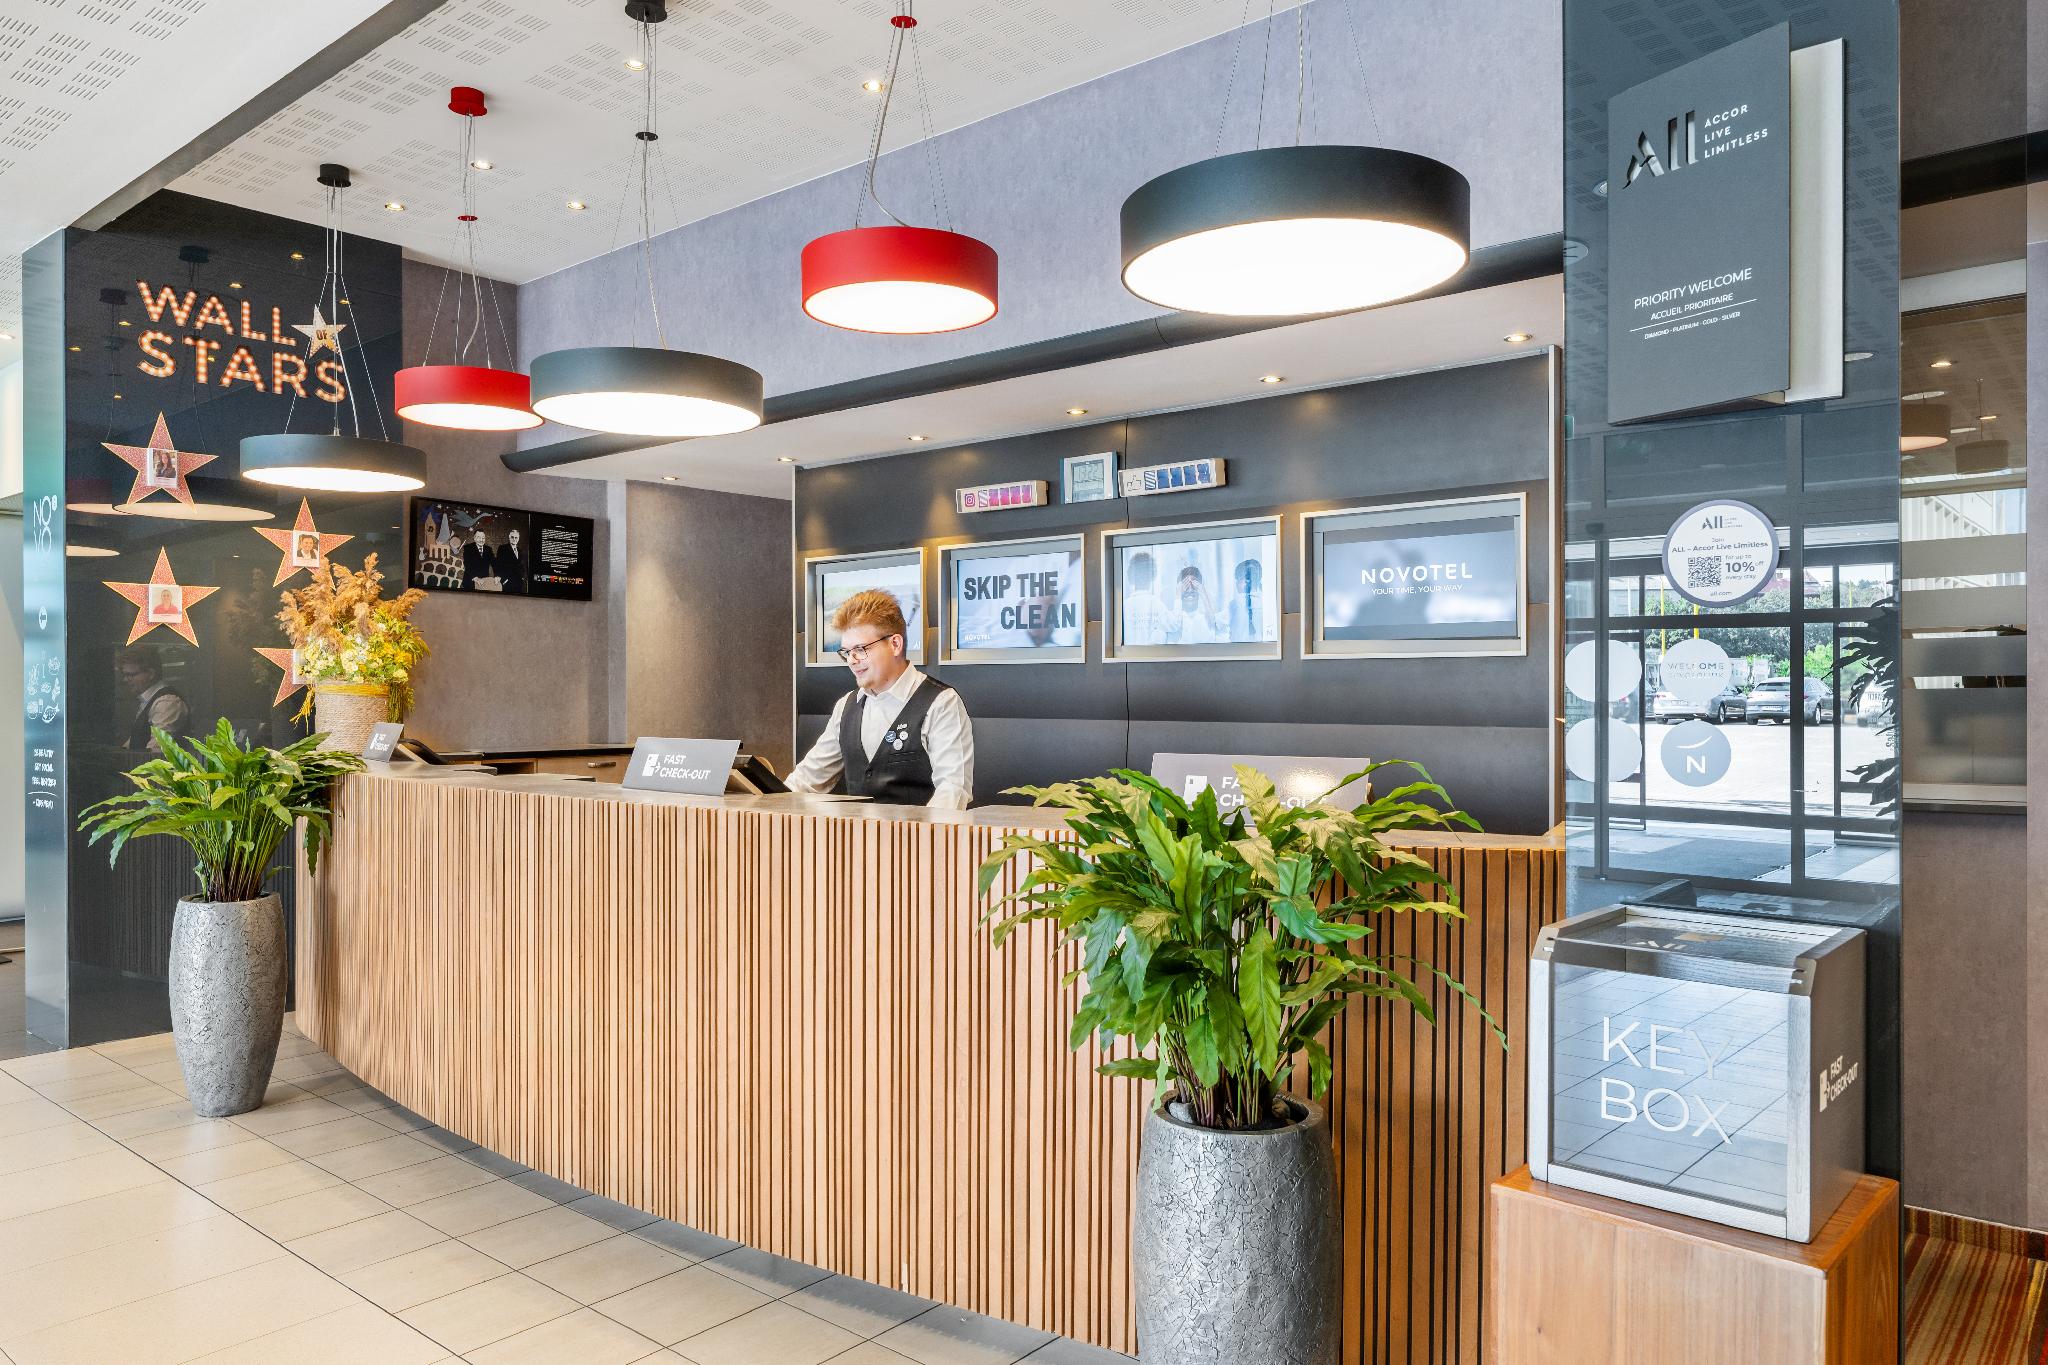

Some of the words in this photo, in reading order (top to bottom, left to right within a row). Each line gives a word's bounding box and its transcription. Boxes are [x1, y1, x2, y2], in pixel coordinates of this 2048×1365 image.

[1704, 105, 1749, 128] ACCOR
[1704, 126, 1731, 143] LIVE
[1704, 128, 1769, 159] LIMITLESS
[1622, 110, 1698, 189] All
[1634, 285, 1687, 310] PRIORITY
[1688, 267, 1753, 295] WELCOME
[136, 279, 297, 346] WALL
[1650, 306, 1682, 320] ACCUEIL
[1684, 292, 1734, 312] PRIORITAIRE
[1644, 329, 1669, 340] DIAMOND
[1672, 321, 1700, 332] PLATINUM
[1702, 316, 1718, 325] GOLD
[1721, 311, 1741, 321] SILVER
[136, 329, 346, 403] STARS
[1702, 515, 1723, 530] All
[1733, 541, 1769, 550] Limitless
[1361, 562, 1473, 585] NOVOTEL
[1725, 561, 1755, 573] 10%
[964, 574, 1012, 600] SKIP
[1016, 571, 1059, 597] THE
[1372, 587, 1394, 595] YOUR
[1418, 585, 1441, 593] YOUR
[1443, 584, 1463, 592] WAY
[1000, 602, 1076, 630] CLEAN
[660, 767, 711, 780] CHECK-OUT
[664, 754, 687, 765] FAST
[1686, 755, 1706, 775] N
[1602, 1016, 1734, 1080] KEY
[1830, 1055, 1843, 1080] FAST
[1830, 1062, 1859, 1102] CHECK-OUT
[1600, 1076, 1733, 1145] BOX
